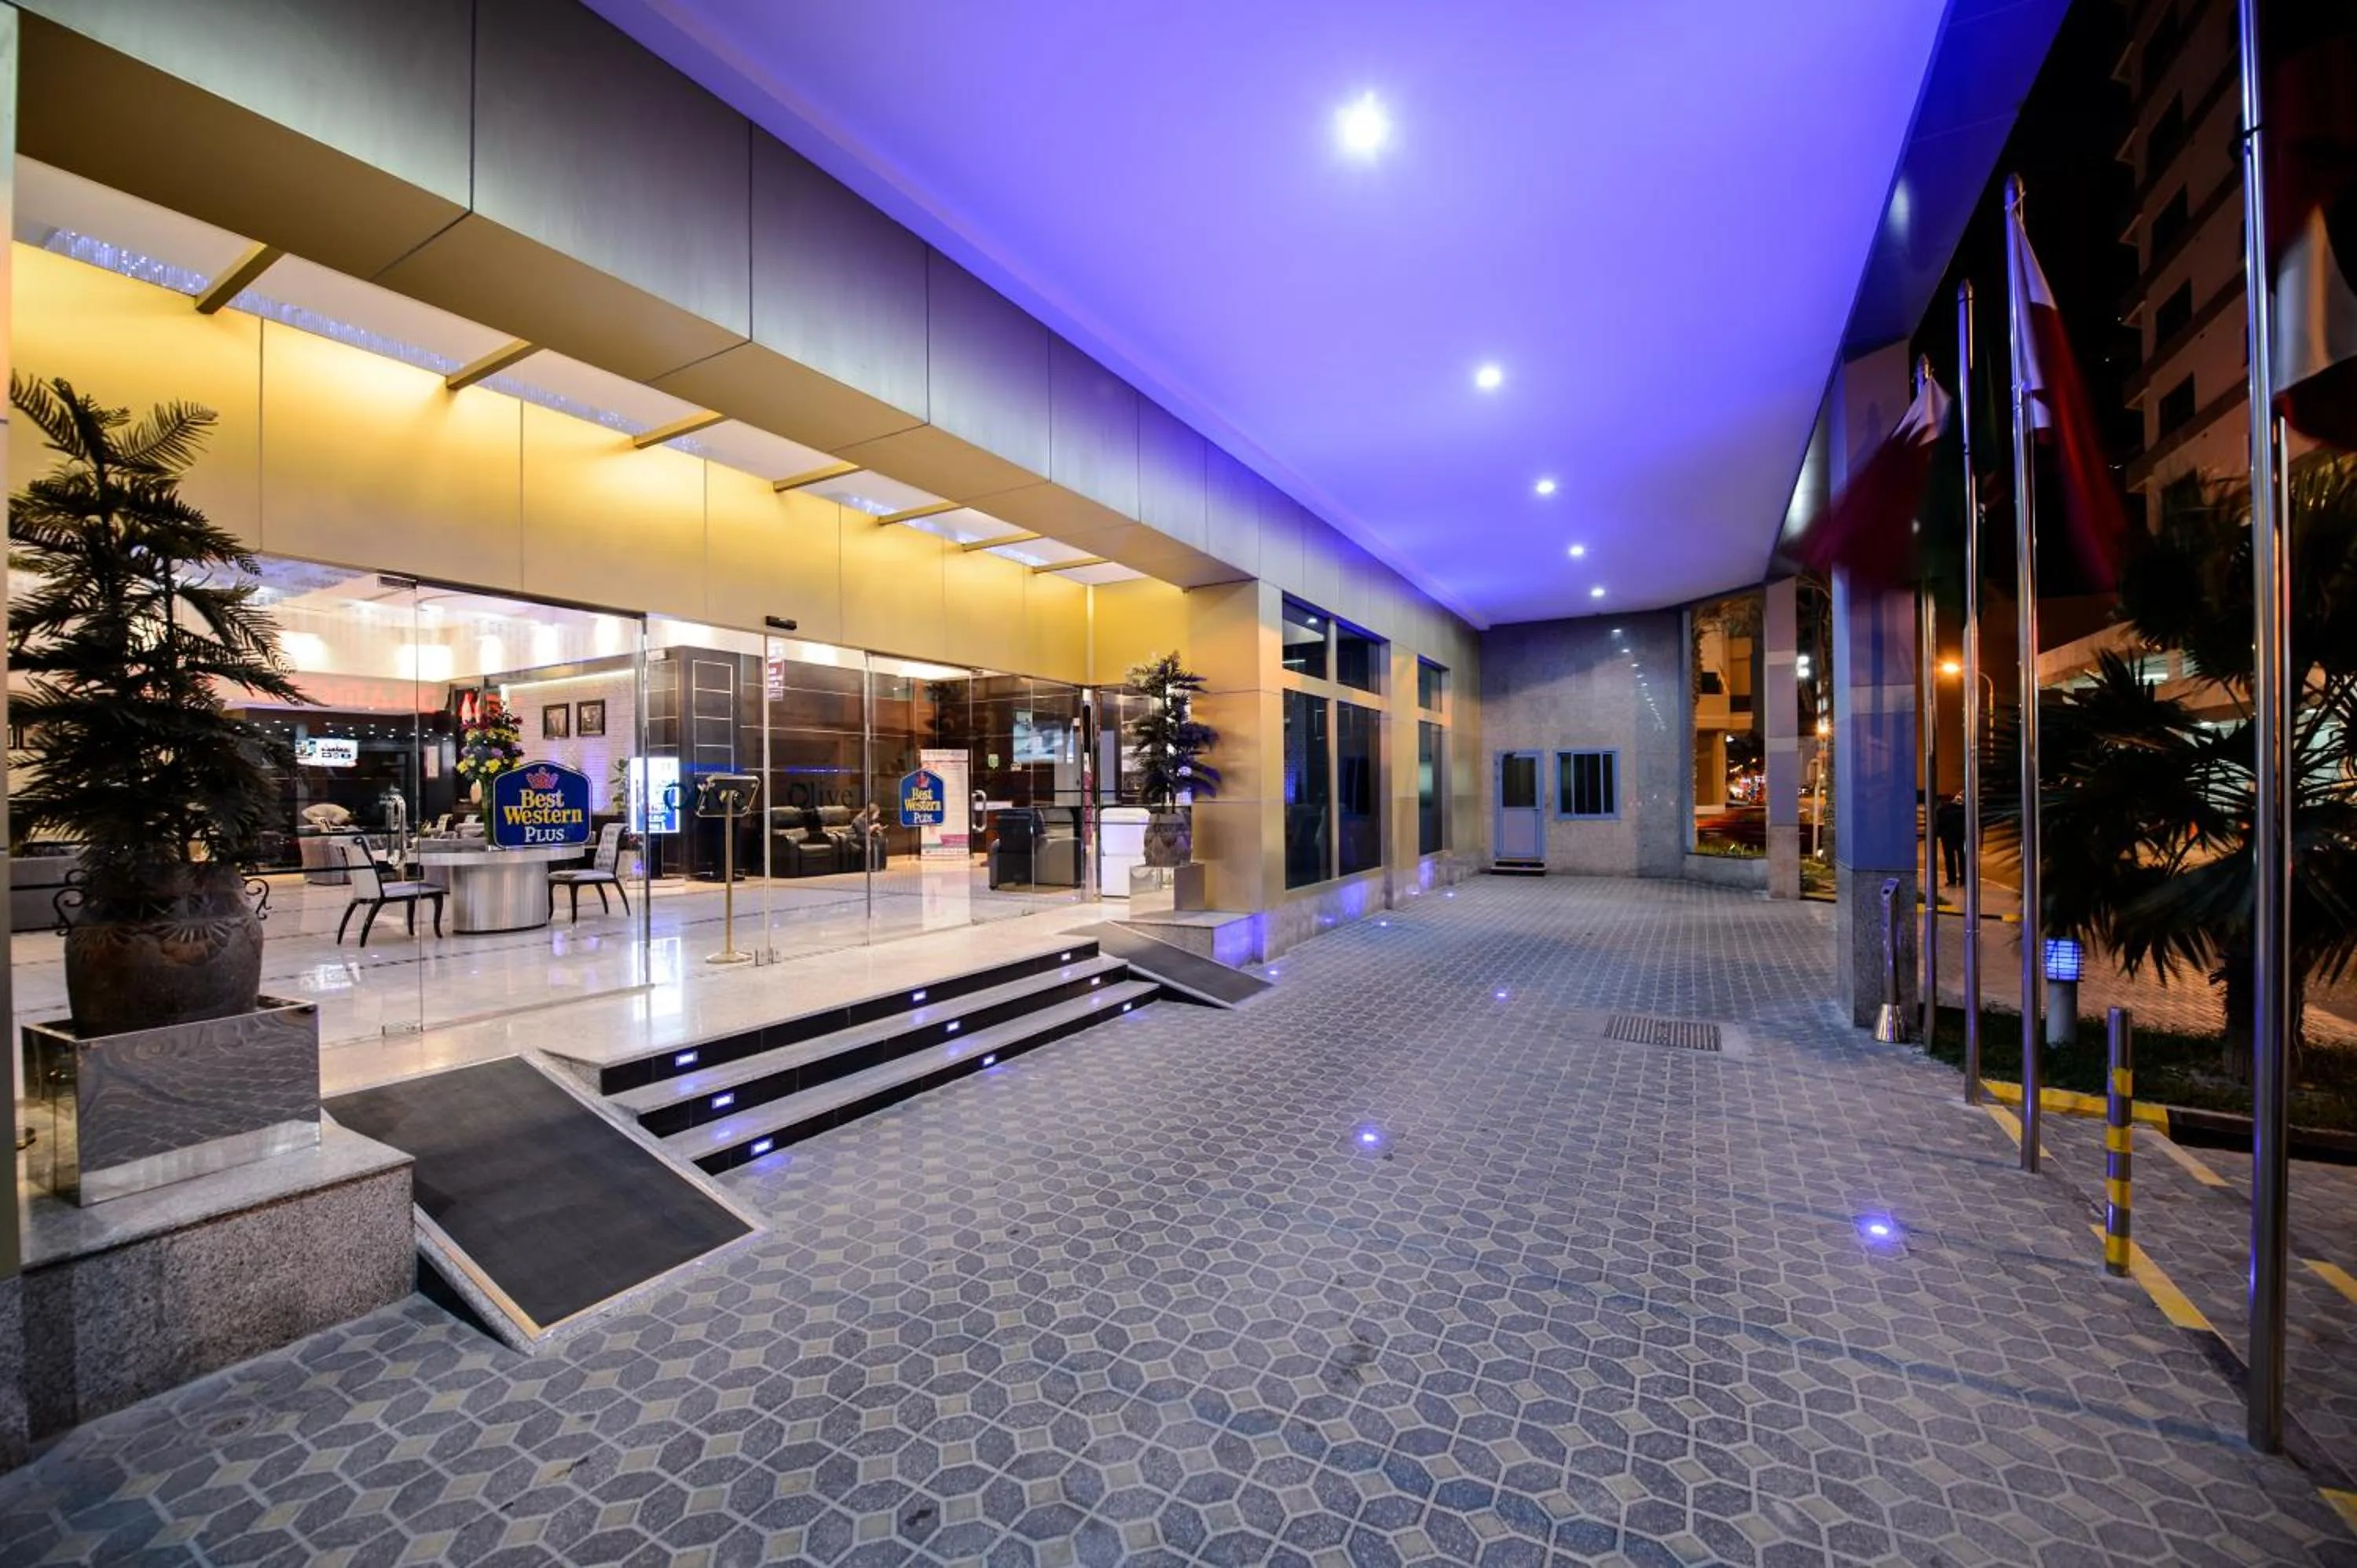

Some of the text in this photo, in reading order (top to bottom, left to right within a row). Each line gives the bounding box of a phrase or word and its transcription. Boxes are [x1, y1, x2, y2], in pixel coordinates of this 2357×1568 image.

[519, 788, 565, 808] Best
[786, 781, 853, 808] Olive
[911, 787, 933, 800] Best
[904, 798, 941, 811] Western
[503, 805, 583, 826] Western
[524, 826, 565, 843] PLUS
